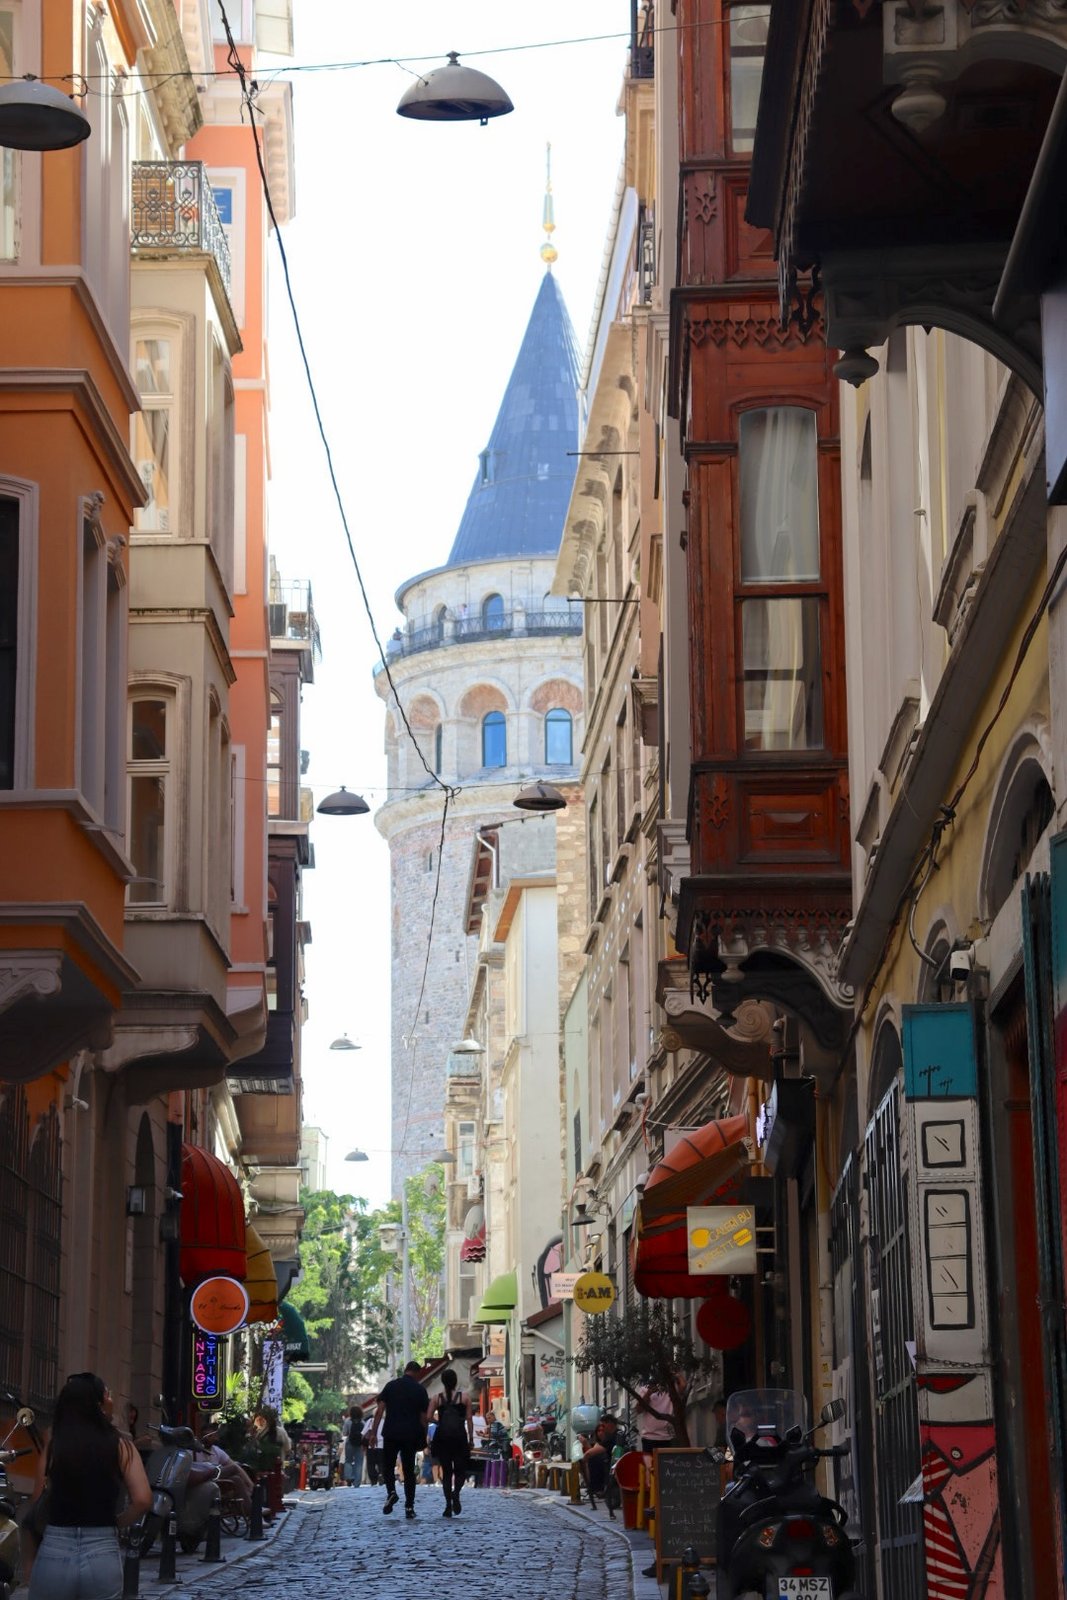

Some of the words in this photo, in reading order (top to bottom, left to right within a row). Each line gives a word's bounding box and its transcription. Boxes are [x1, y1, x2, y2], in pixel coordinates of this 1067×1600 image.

[737, 1208, 752, 1223] BU
[780, 1579, 796, 1591] 34
[799, 1579, 828, 1591] MSZ
